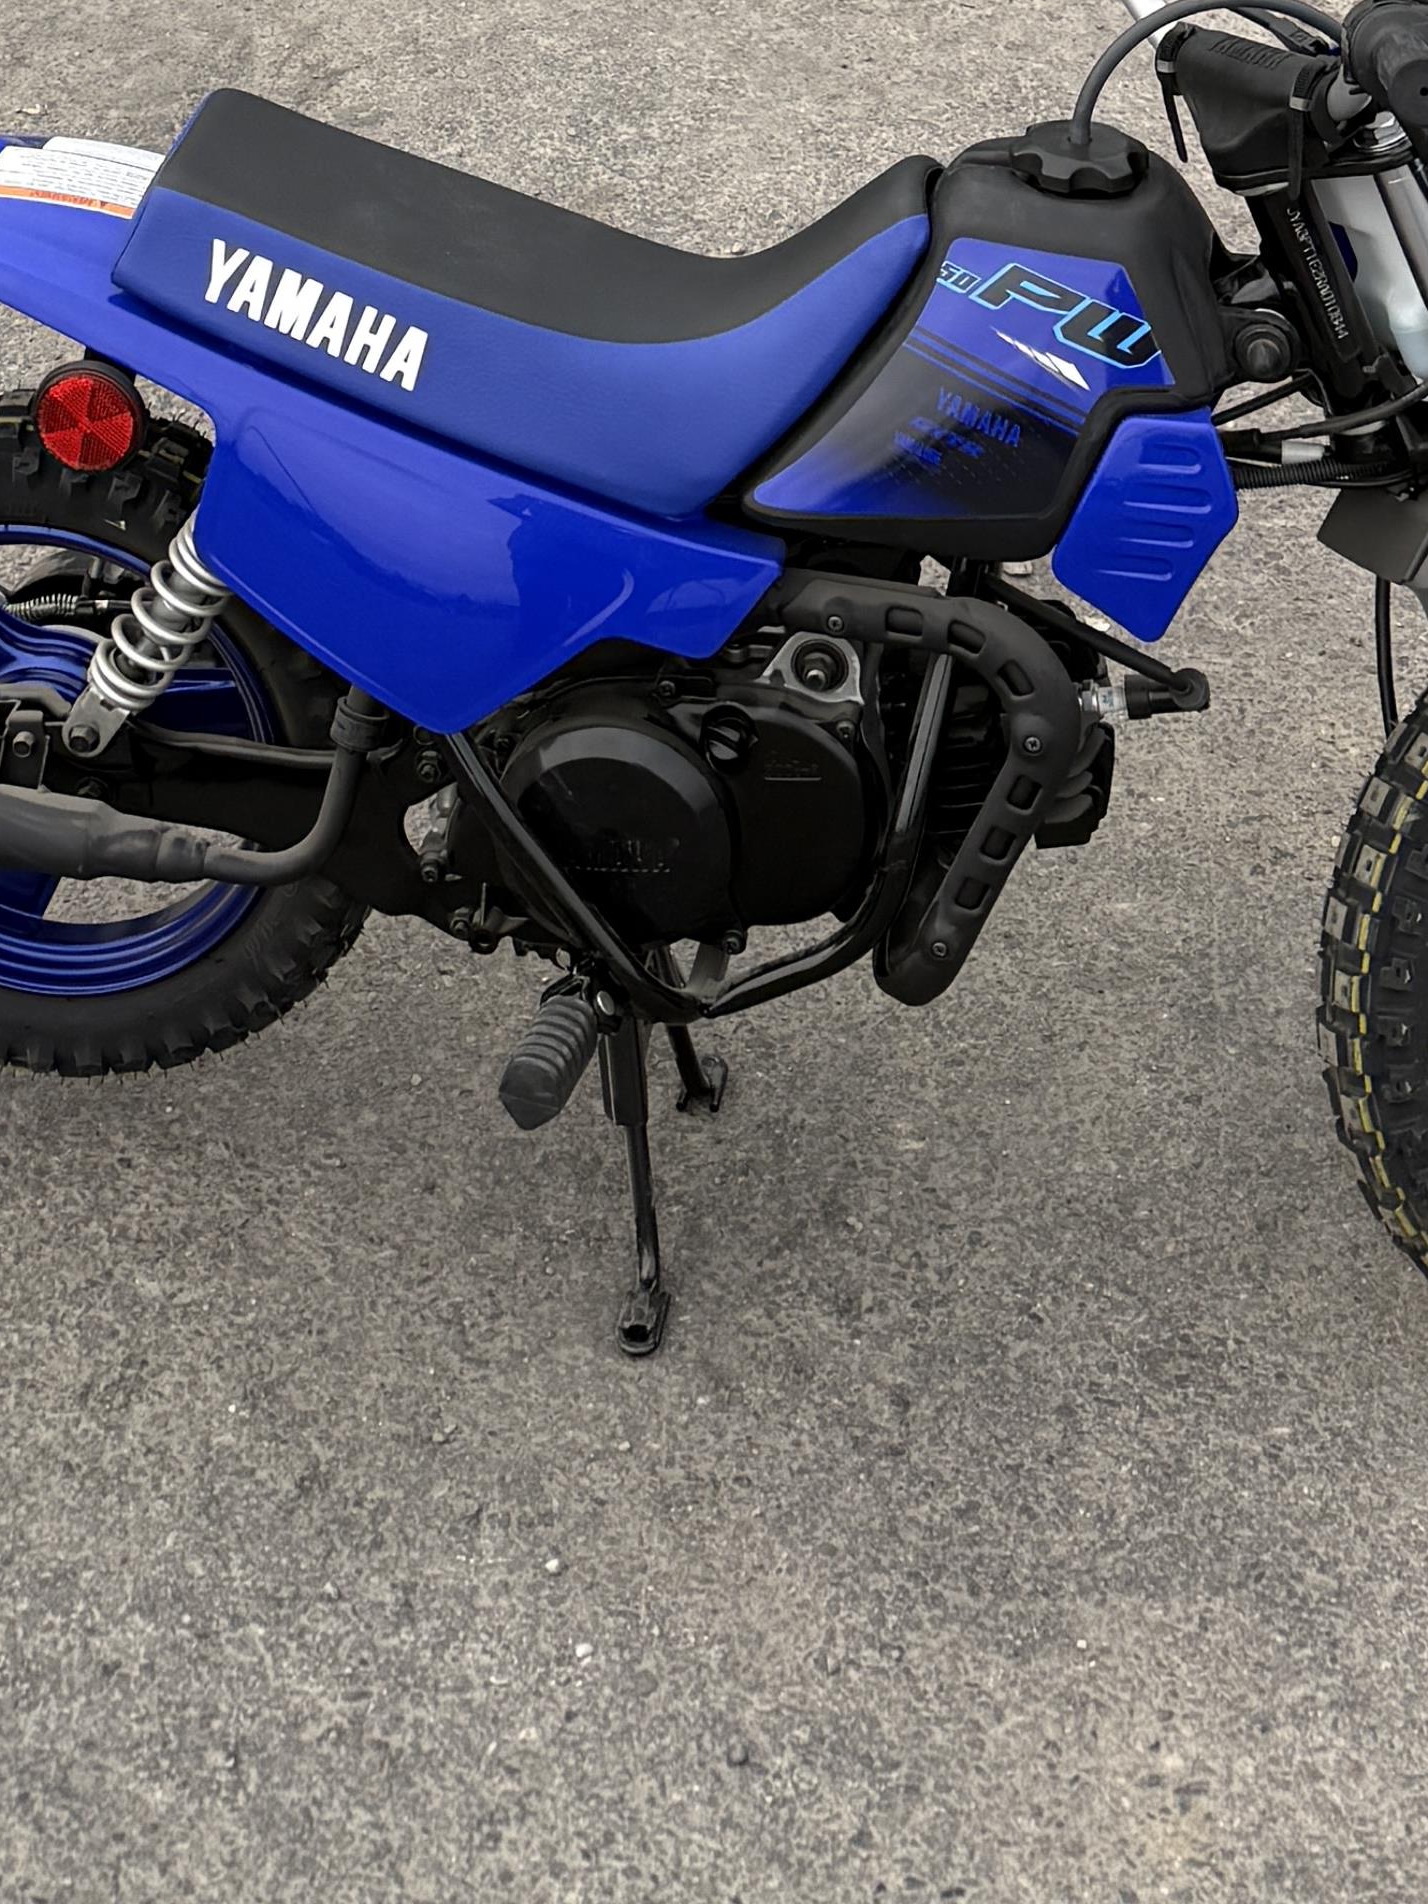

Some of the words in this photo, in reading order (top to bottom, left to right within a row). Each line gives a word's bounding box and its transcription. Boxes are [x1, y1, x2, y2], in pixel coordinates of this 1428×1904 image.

[204, 238, 428, 392] YAMAHA
[969, 263, 1162, 369] PW
[937, 386, 1021, 448] YAMAHA
